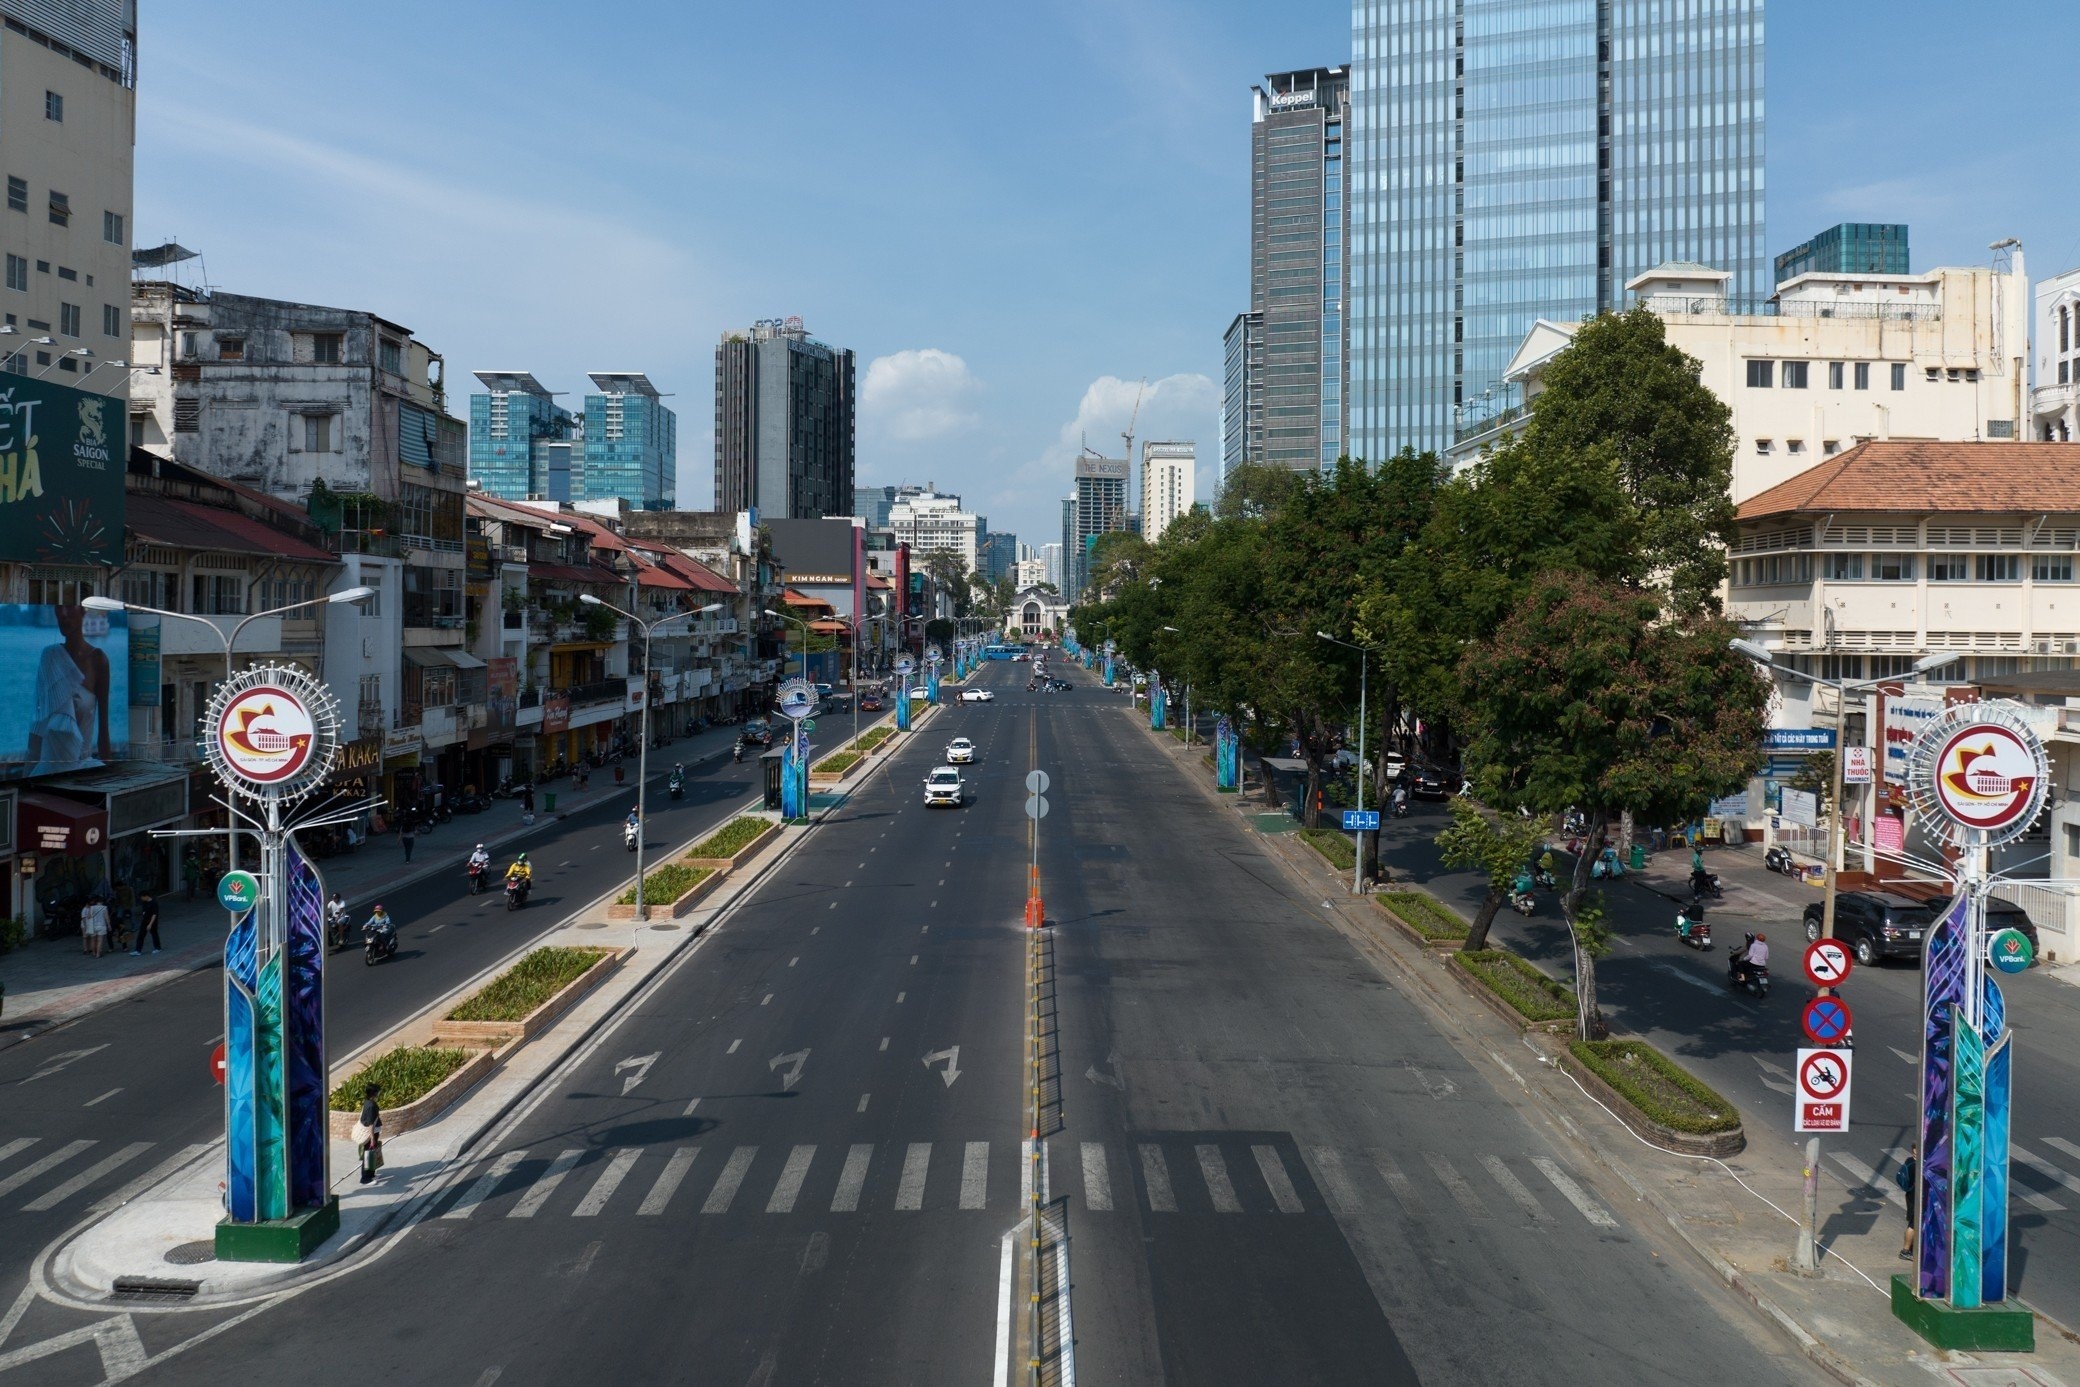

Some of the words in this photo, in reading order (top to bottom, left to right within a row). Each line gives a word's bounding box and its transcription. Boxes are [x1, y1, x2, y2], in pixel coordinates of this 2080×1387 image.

[1272, 91, 1313, 106] Keppel
[86, 438, 97, 447] BIA
[73, 444, 109, 460] SAIGON
[77, 459, 107, 471] SPECIAL
[1099, 464, 1122, 474] NEXUS
[1851, 758, 1866, 766] NHÀ
[1846, 767, 1869, 776] THUỐC
[1999, 955, 2025, 963] VPBank
[1813, 1104, 1833, 1116] CẤM
